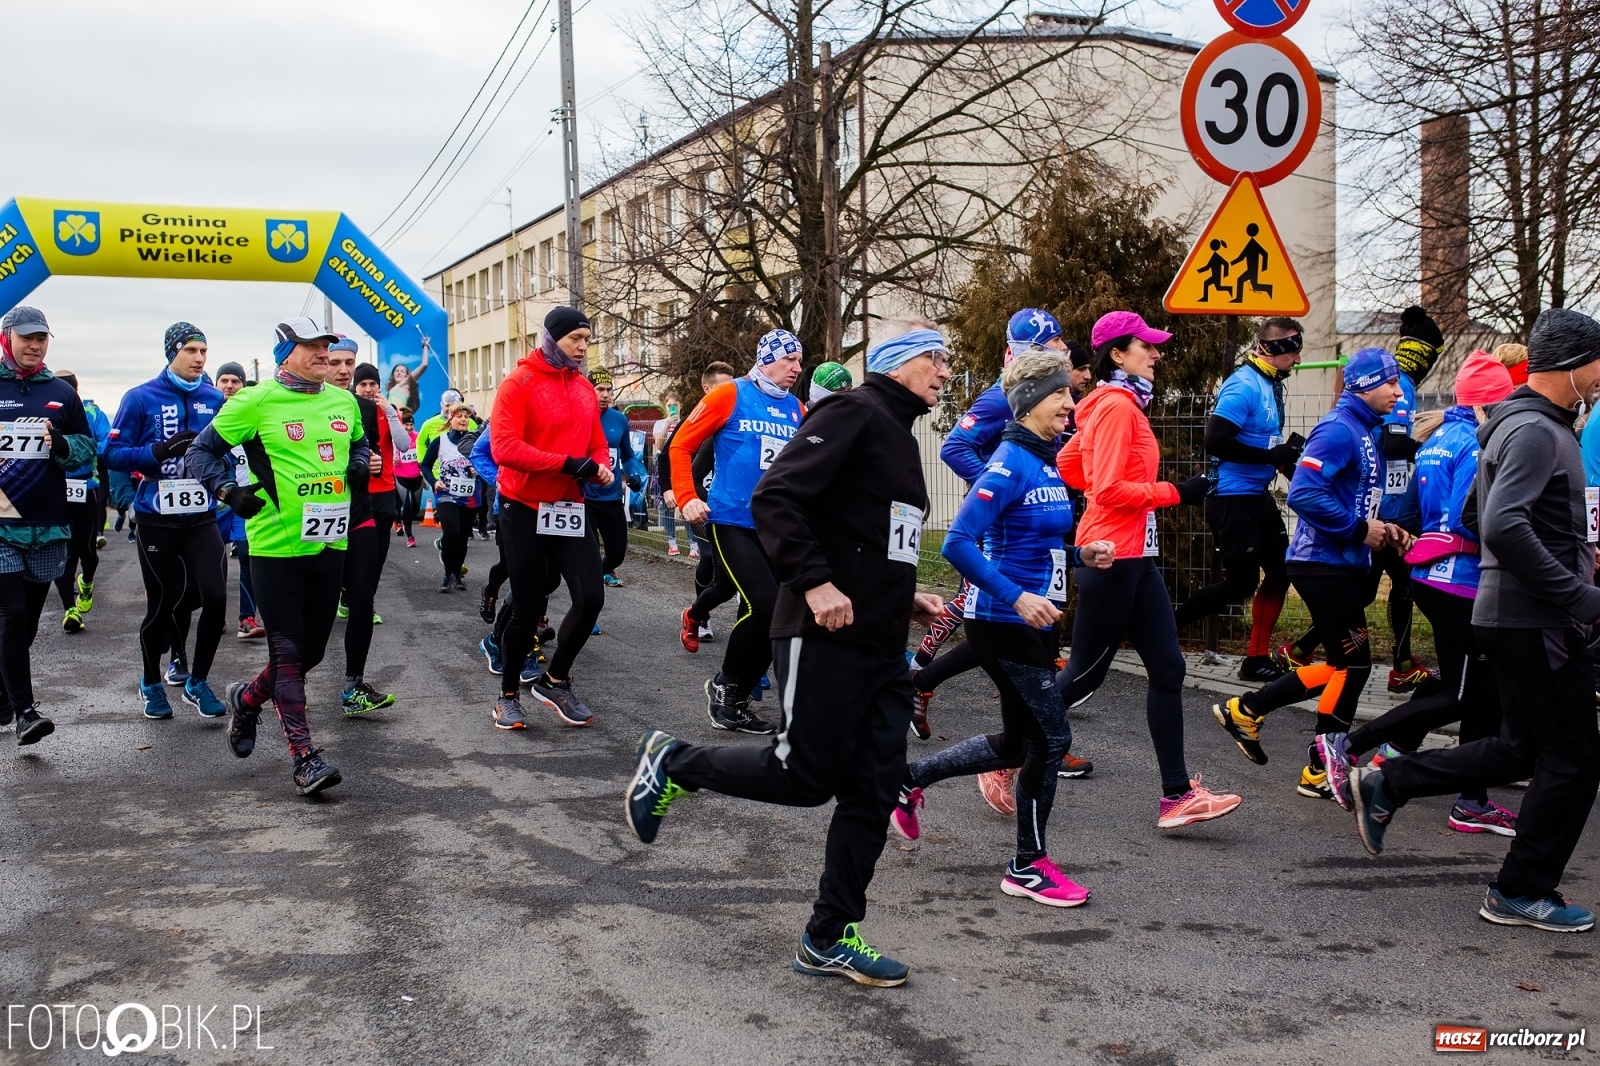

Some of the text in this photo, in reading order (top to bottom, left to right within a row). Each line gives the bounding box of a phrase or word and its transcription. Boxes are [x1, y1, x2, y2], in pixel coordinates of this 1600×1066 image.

[1205, 68, 1299, 147] 30
[142, 213, 226, 228] Gmina
[119, 228, 249, 247] Pietrowice
[0, 244, 34, 280] nych
[137, 247, 232, 264] Wielkie
[341, 238, 422, 316] Gmina ludzi
[327, 256, 404, 328] aktywnych
[739, 419, 798, 439] RUNNE
[0, 435, 46, 452] 277
[763, 448, 775, 464] 2
[294, 471, 334, 479] ENERGETYKA
[1388, 472, 1407, 488] 321
[297, 476, 347, 497] ensol
[452, 483, 474, 493] 358
[164, 490, 206, 508] 183
[304, 516, 347, 536] 275
[541, 512, 582, 530] 159
[894, 524, 920, 555] 14
[1053, 567, 1066, 591] 3
